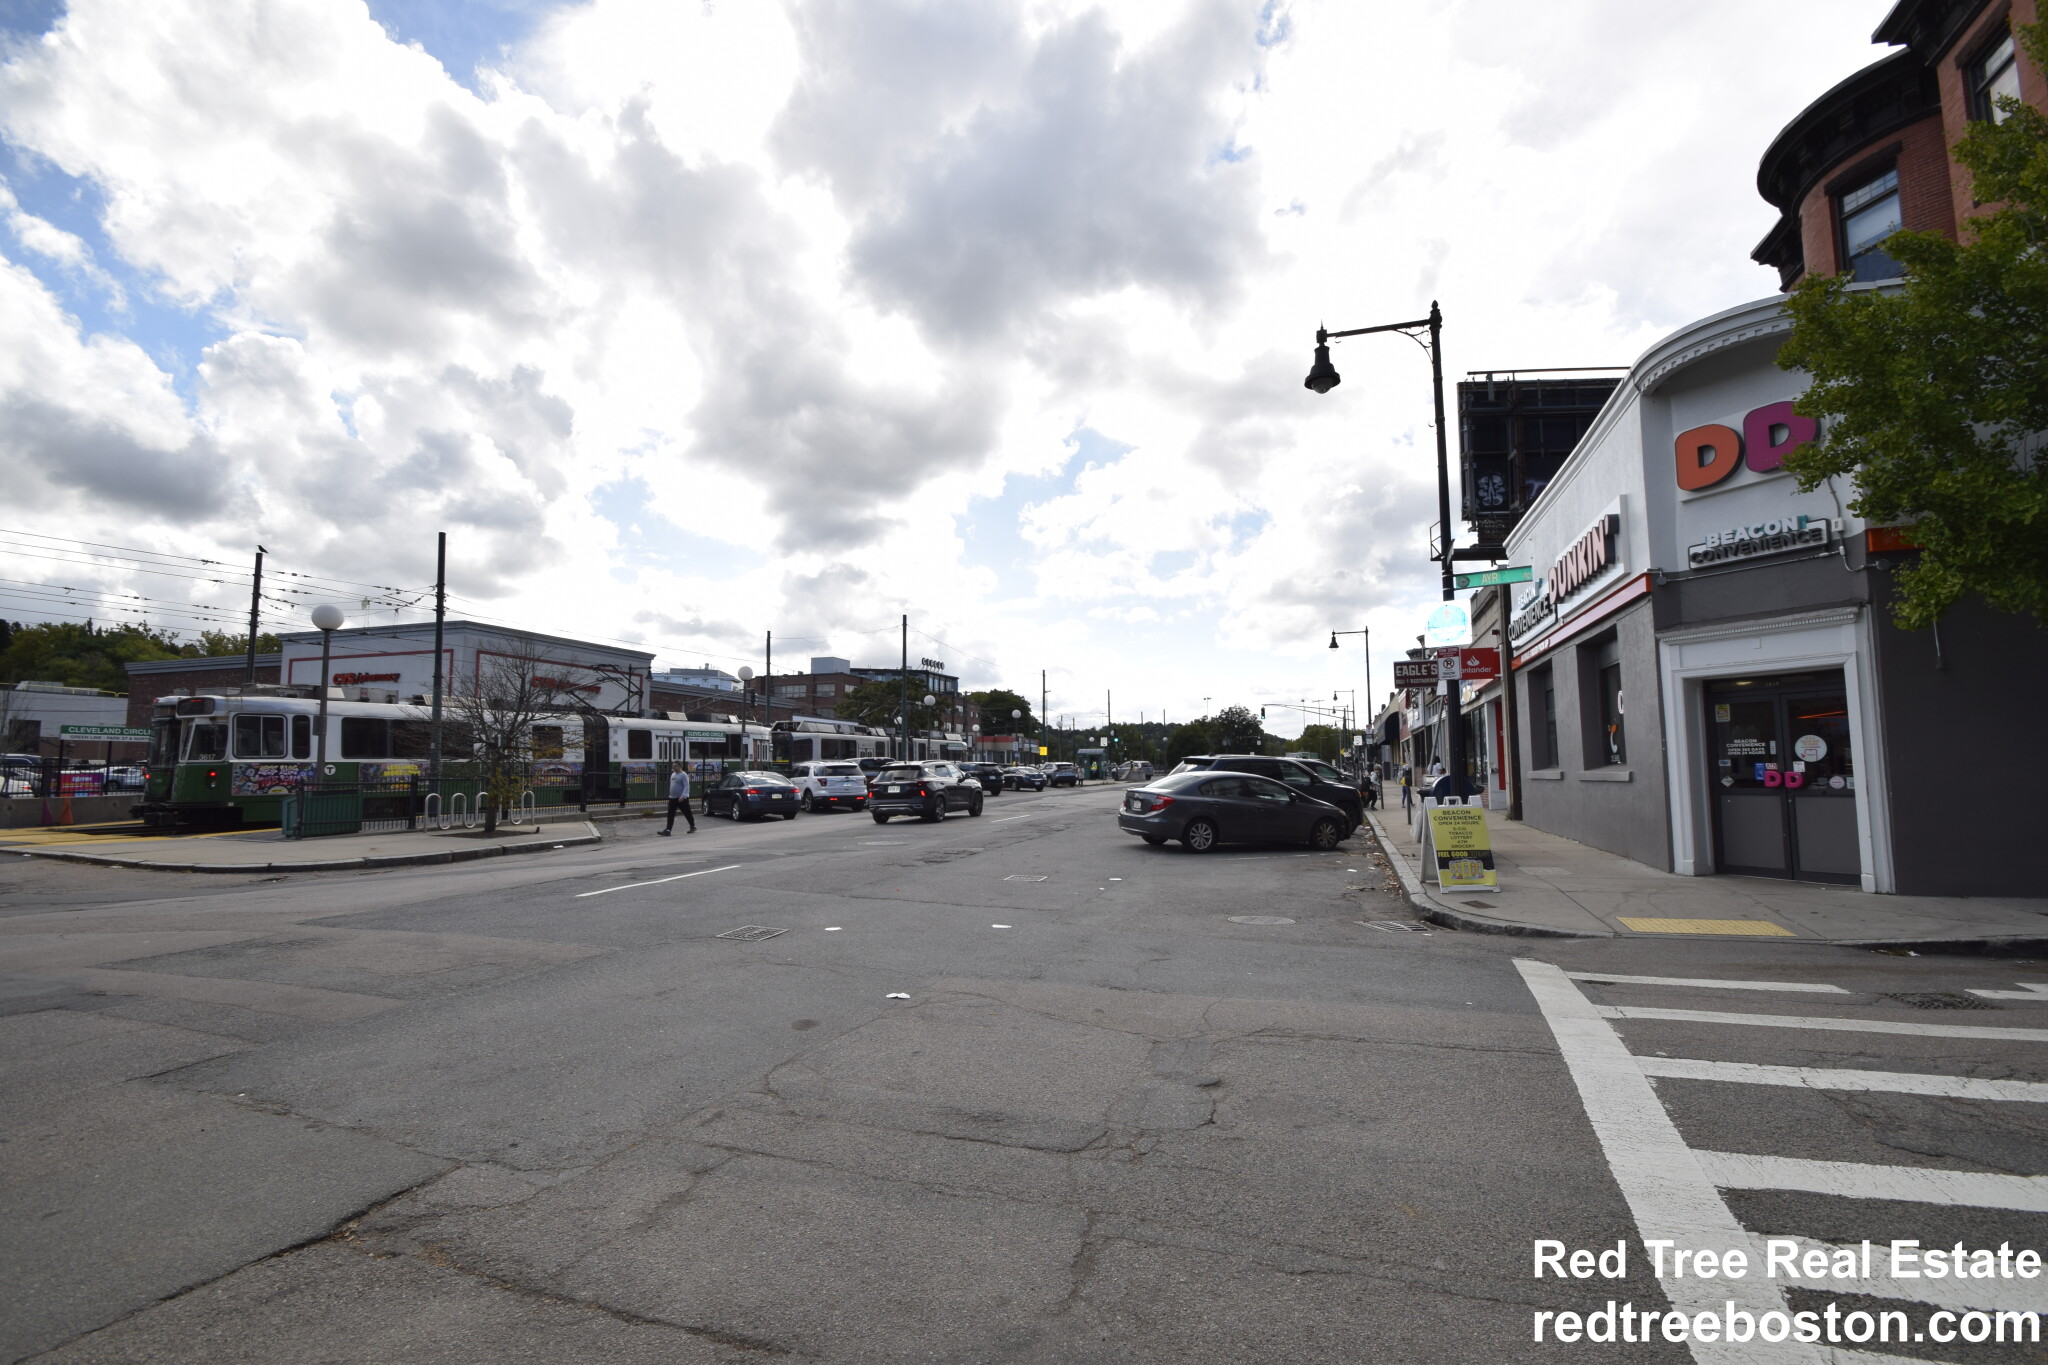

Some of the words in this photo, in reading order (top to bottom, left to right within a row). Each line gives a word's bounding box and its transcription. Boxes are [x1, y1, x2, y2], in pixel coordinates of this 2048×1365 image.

[1690, 527, 1823, 564] CONVENIENCE
[1705, 515, 1803, 548] BEACON
[1548, 514, 1614, 604] DUNKIN'
[1482, 572, 1499, 584] AYR
[1518, 583, 1537, 608] BEACON
[1507, 597, 1550, 642] CONVENIENCE
[1396, 664, 1438, 676] EAGLE'S
[68, 726, 121, 735] CLEVELAND
